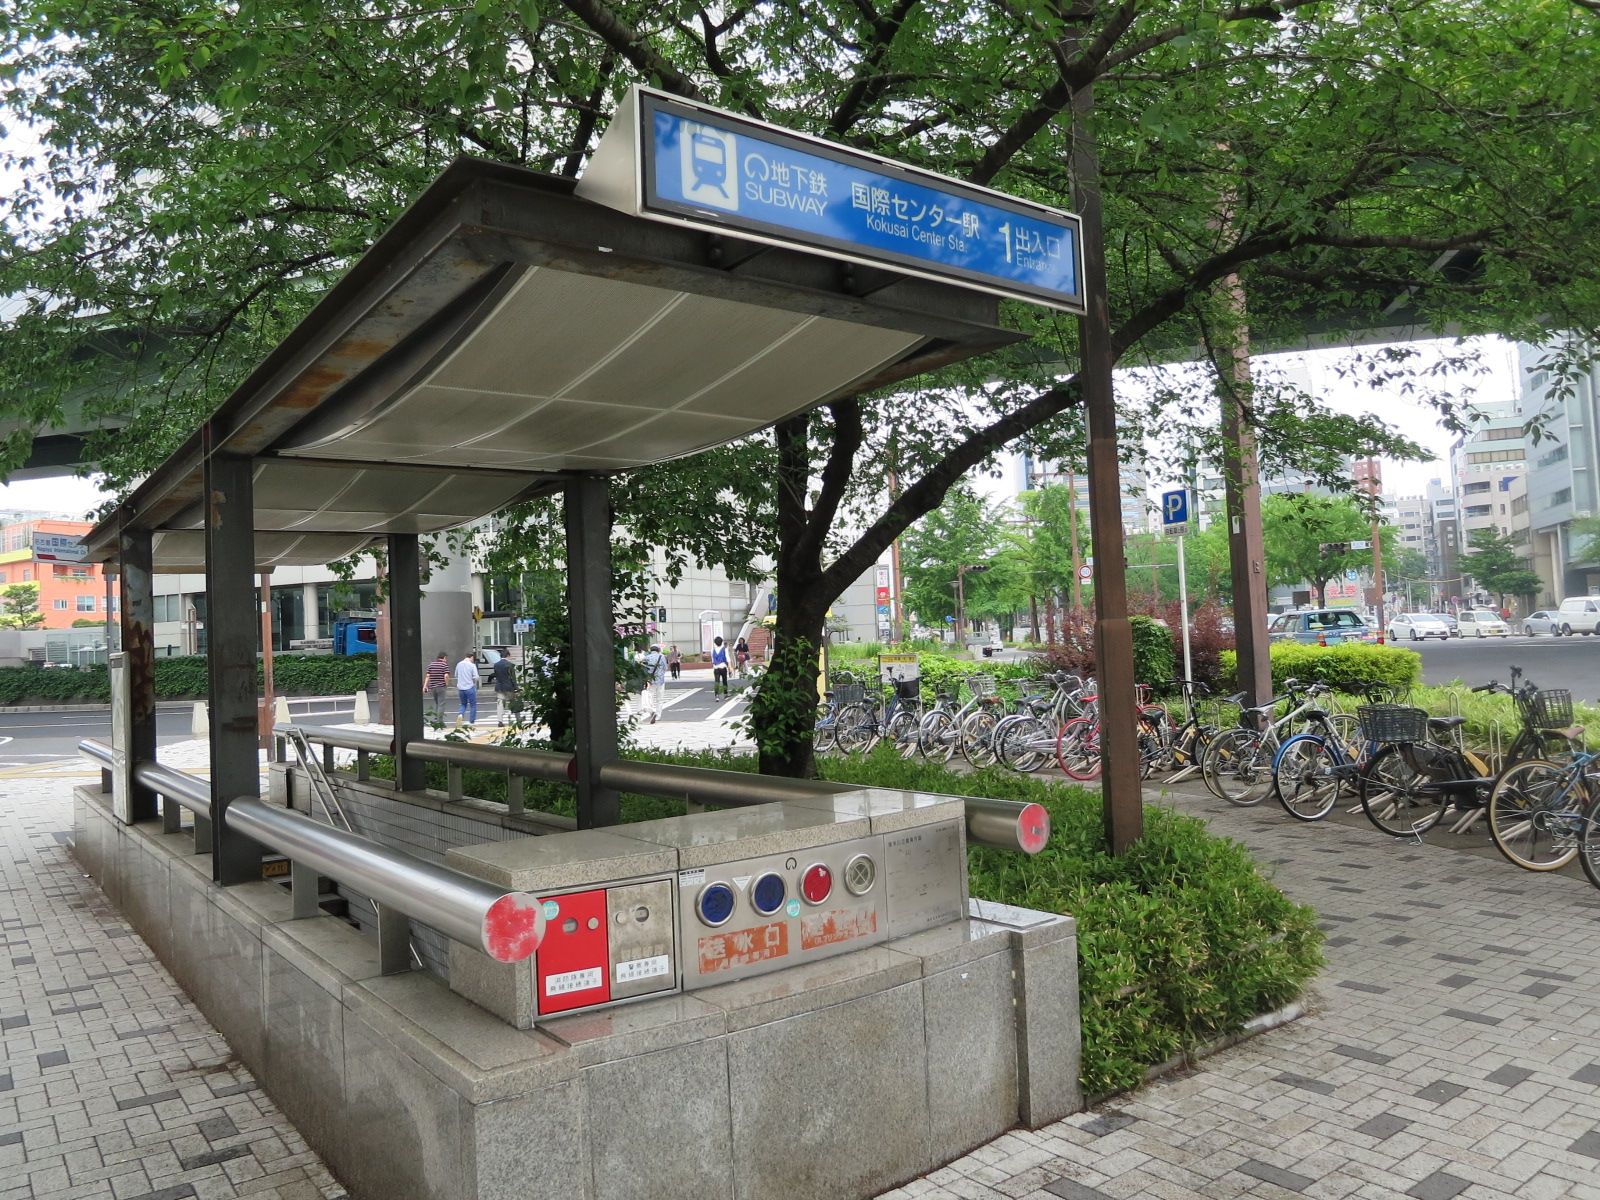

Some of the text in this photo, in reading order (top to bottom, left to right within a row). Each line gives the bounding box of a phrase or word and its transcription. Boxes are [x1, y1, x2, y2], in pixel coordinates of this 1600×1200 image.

[770, 160, 829, 197] 地下鉄
[745, 181, 829, 217] SUBWAY
[851, 181, 981, 239] 国際センター駅
[866, 213, 909, 238] Kokusai
[911, 225, 946, 247] Center
[998, 222, 1012, 264] 1
[1015, 226, 1061, 259] 出入口
[1168, 494, 1182, 521] P
